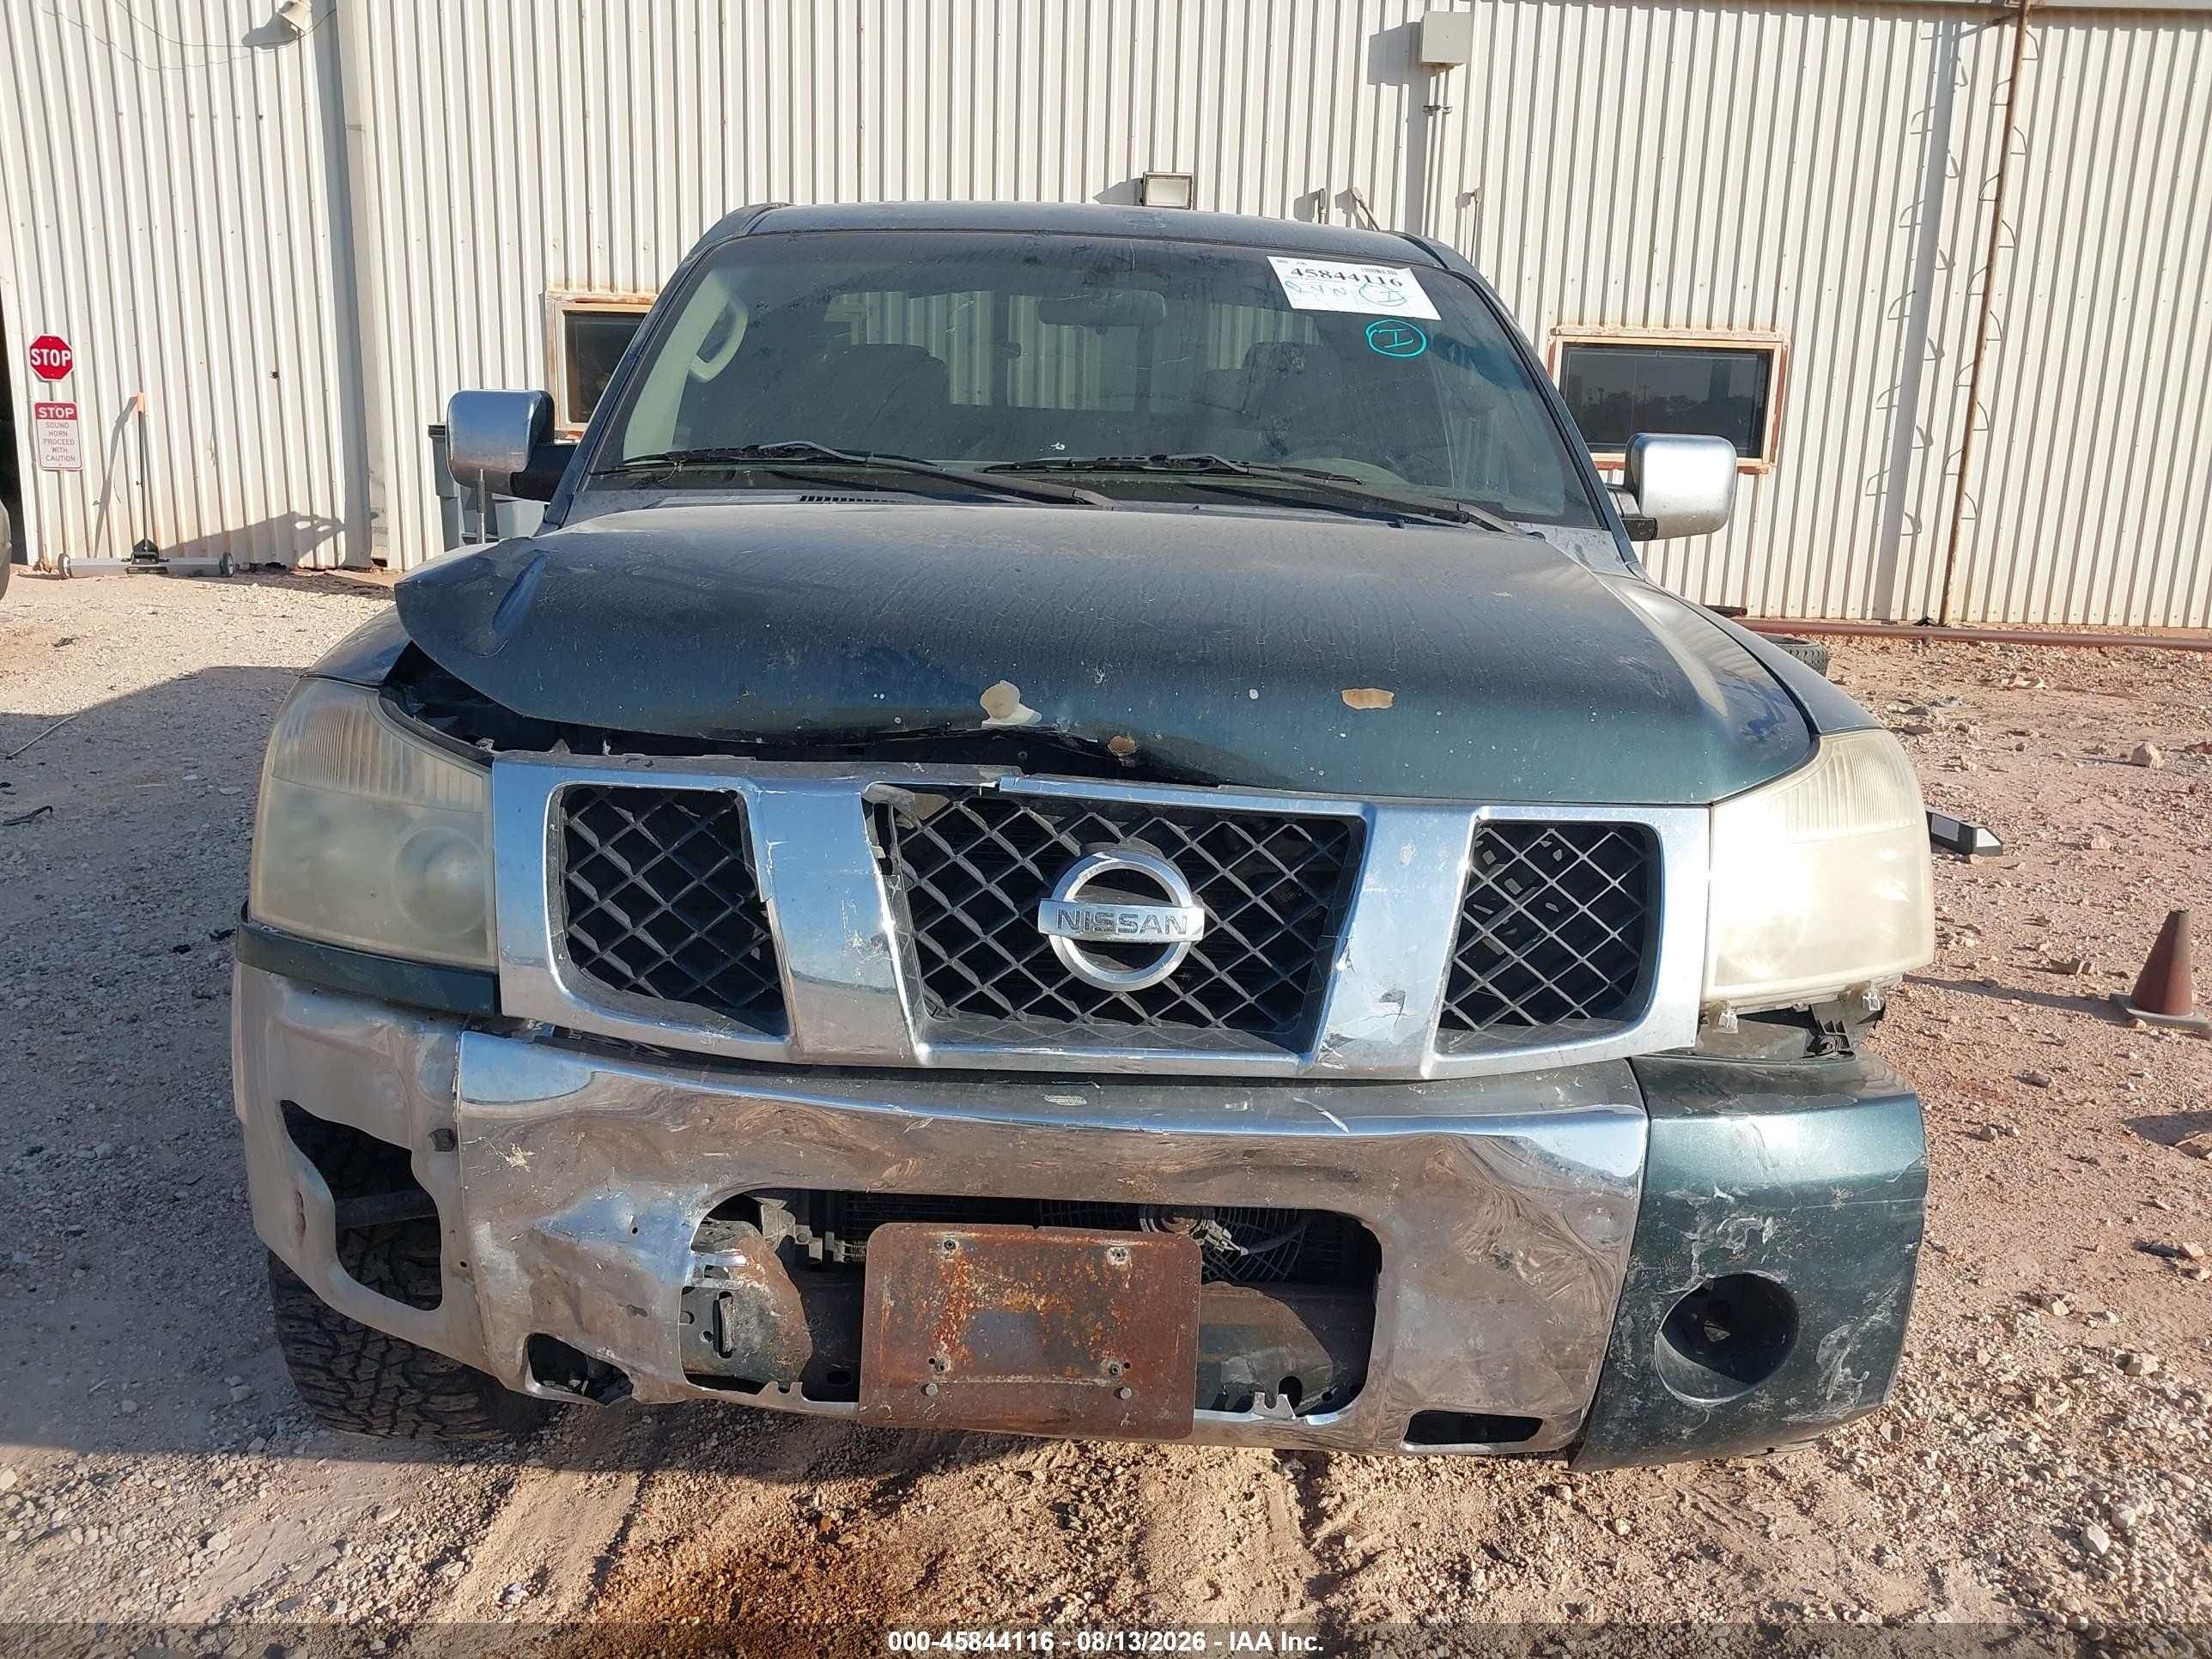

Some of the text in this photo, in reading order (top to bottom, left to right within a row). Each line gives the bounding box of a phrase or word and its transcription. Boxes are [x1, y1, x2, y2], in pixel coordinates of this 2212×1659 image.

[1291, 267, 1403, 287] 45844116
[31, 348, 71, 367] STOP
[38, 407, 75, 419] STOP
[1057, 908, 1188, 934] NISSAN
